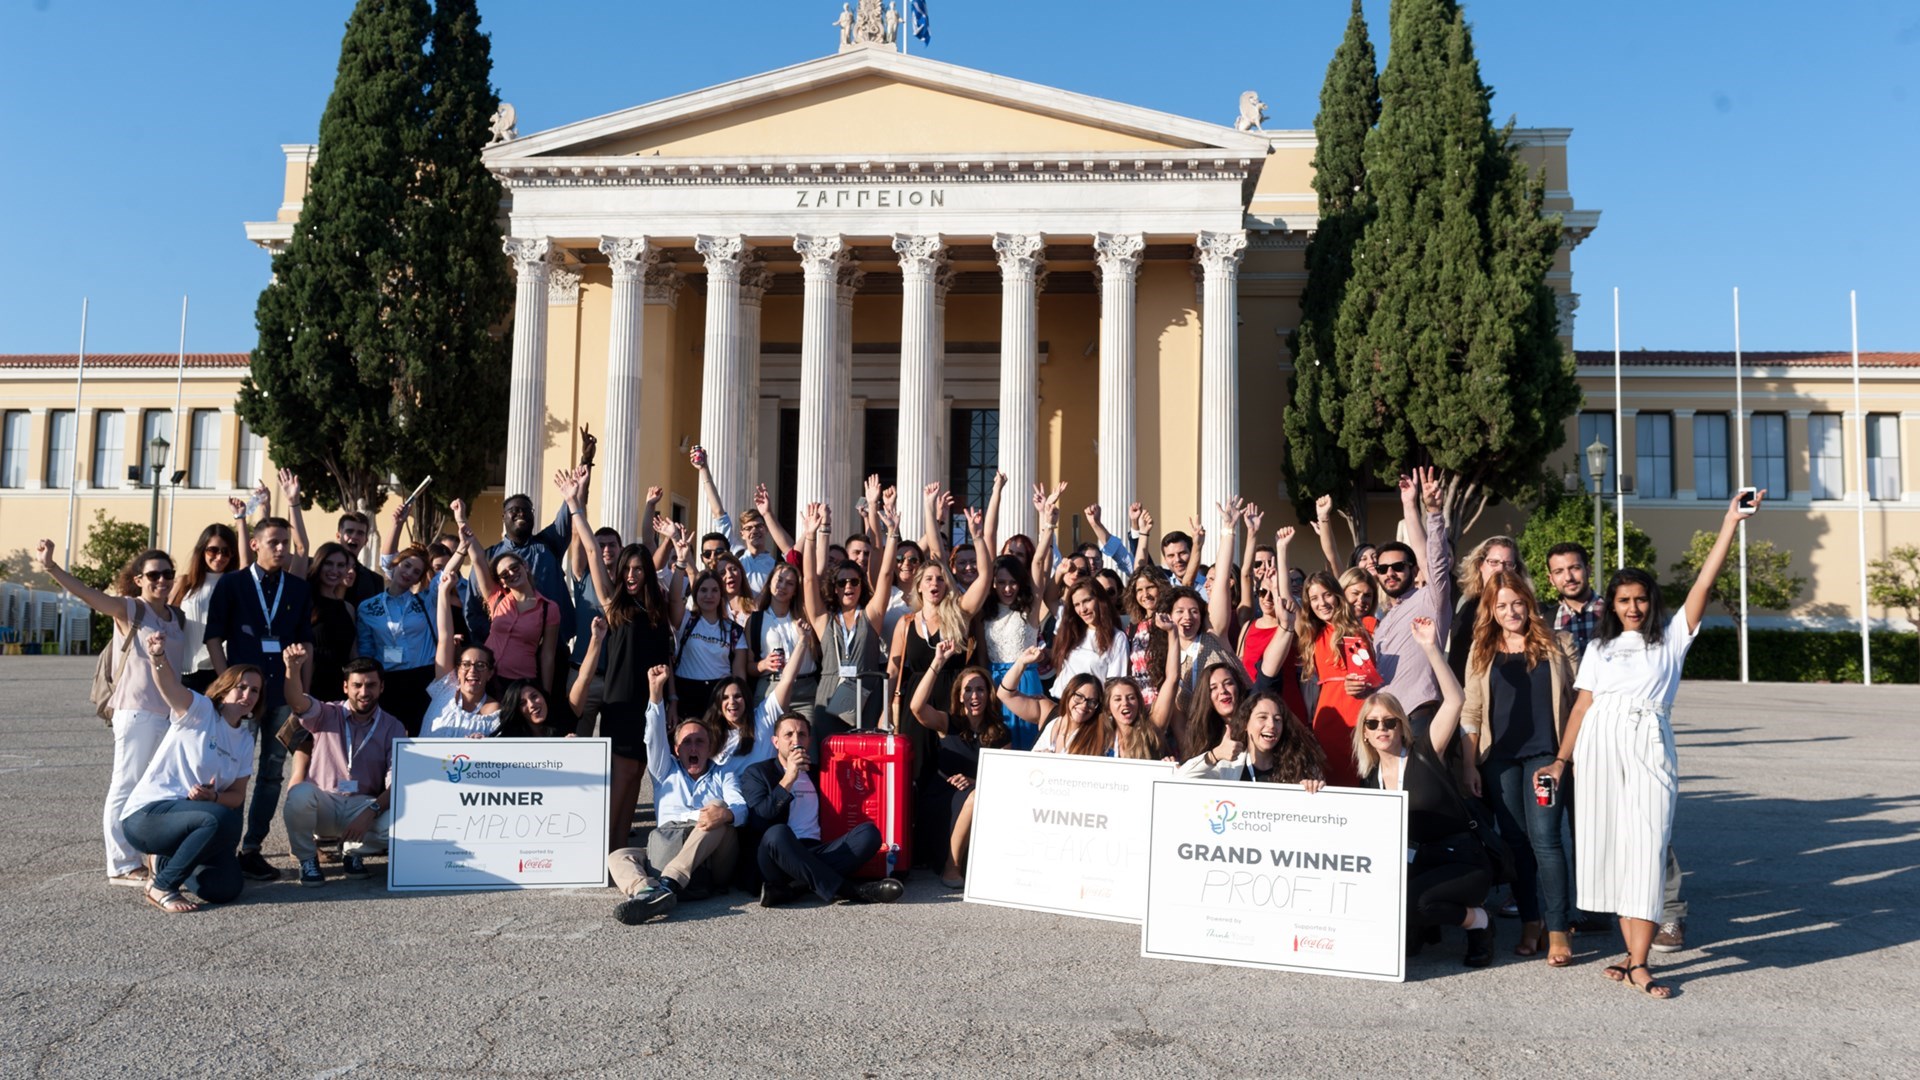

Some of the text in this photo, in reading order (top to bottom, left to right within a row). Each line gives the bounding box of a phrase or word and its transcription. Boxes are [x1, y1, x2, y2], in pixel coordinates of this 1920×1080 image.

[474, 760, 563, 770] entrepreneurship
[466, 770, 500, 779] school
[1047, 777, 1130, 792] entrepreneurship
[459, 792, 544, 806] WINNER
[1032, 808, 1109, 829] WINNER
[1241, 809, 1348, 826] entrepreneurship
[1231, 821, 1272, 832] school
[1177, 843, 1372, 873] GRAND WINNER
